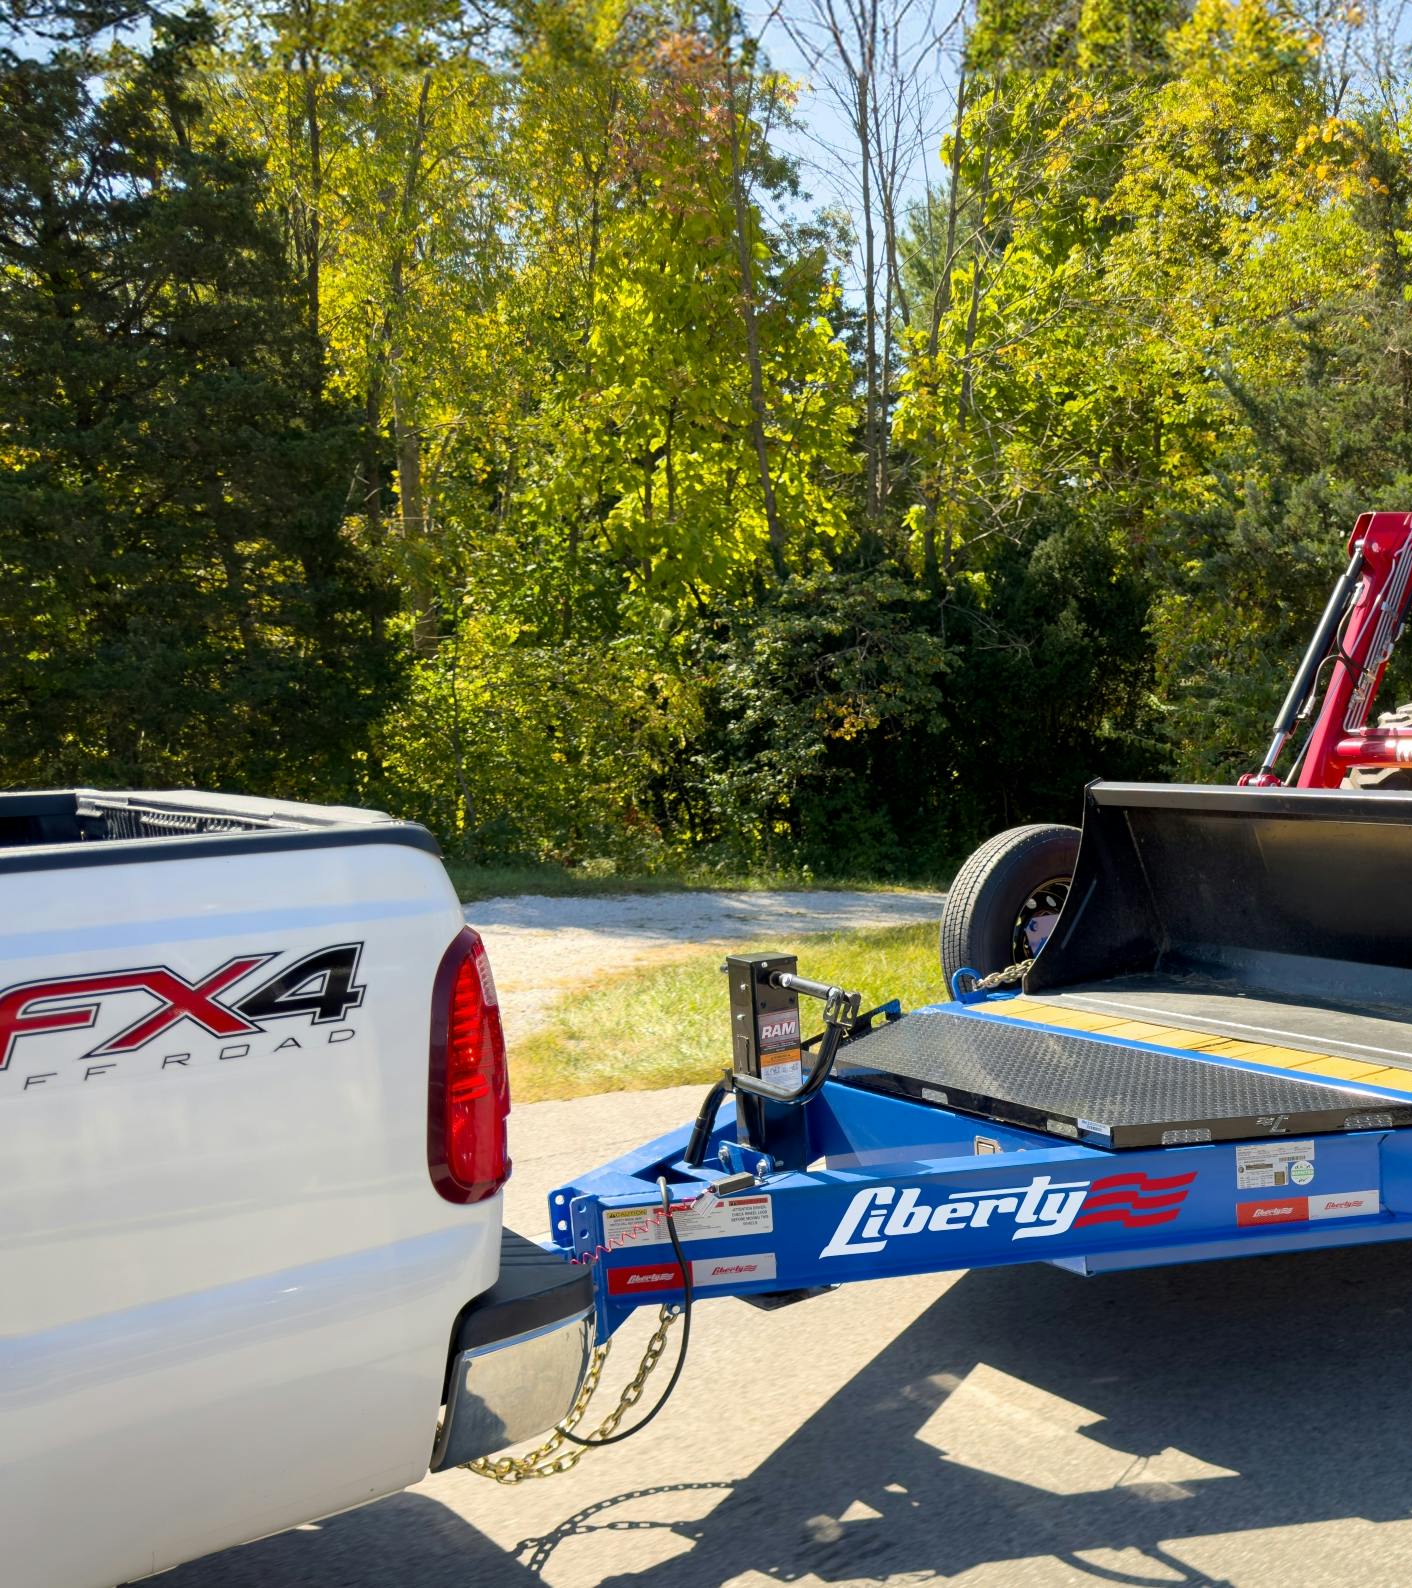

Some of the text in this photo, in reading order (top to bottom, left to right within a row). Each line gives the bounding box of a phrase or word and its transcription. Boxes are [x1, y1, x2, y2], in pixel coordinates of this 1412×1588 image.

[0, 940, 367, 1071] FX4
[761, 1021, 796, 1040] RAM
[23, 1028, 356, 1091] FF ROAD
[1252, 1207, 1281, 1218] Liberty
[1324, 1200, 1352, 1210] Liberty
[819, 1176, 1091, 1260] Liberty
[712, 1264, 745, 1276] Liberty
[626, 1272, 662, 1285] Liberty
